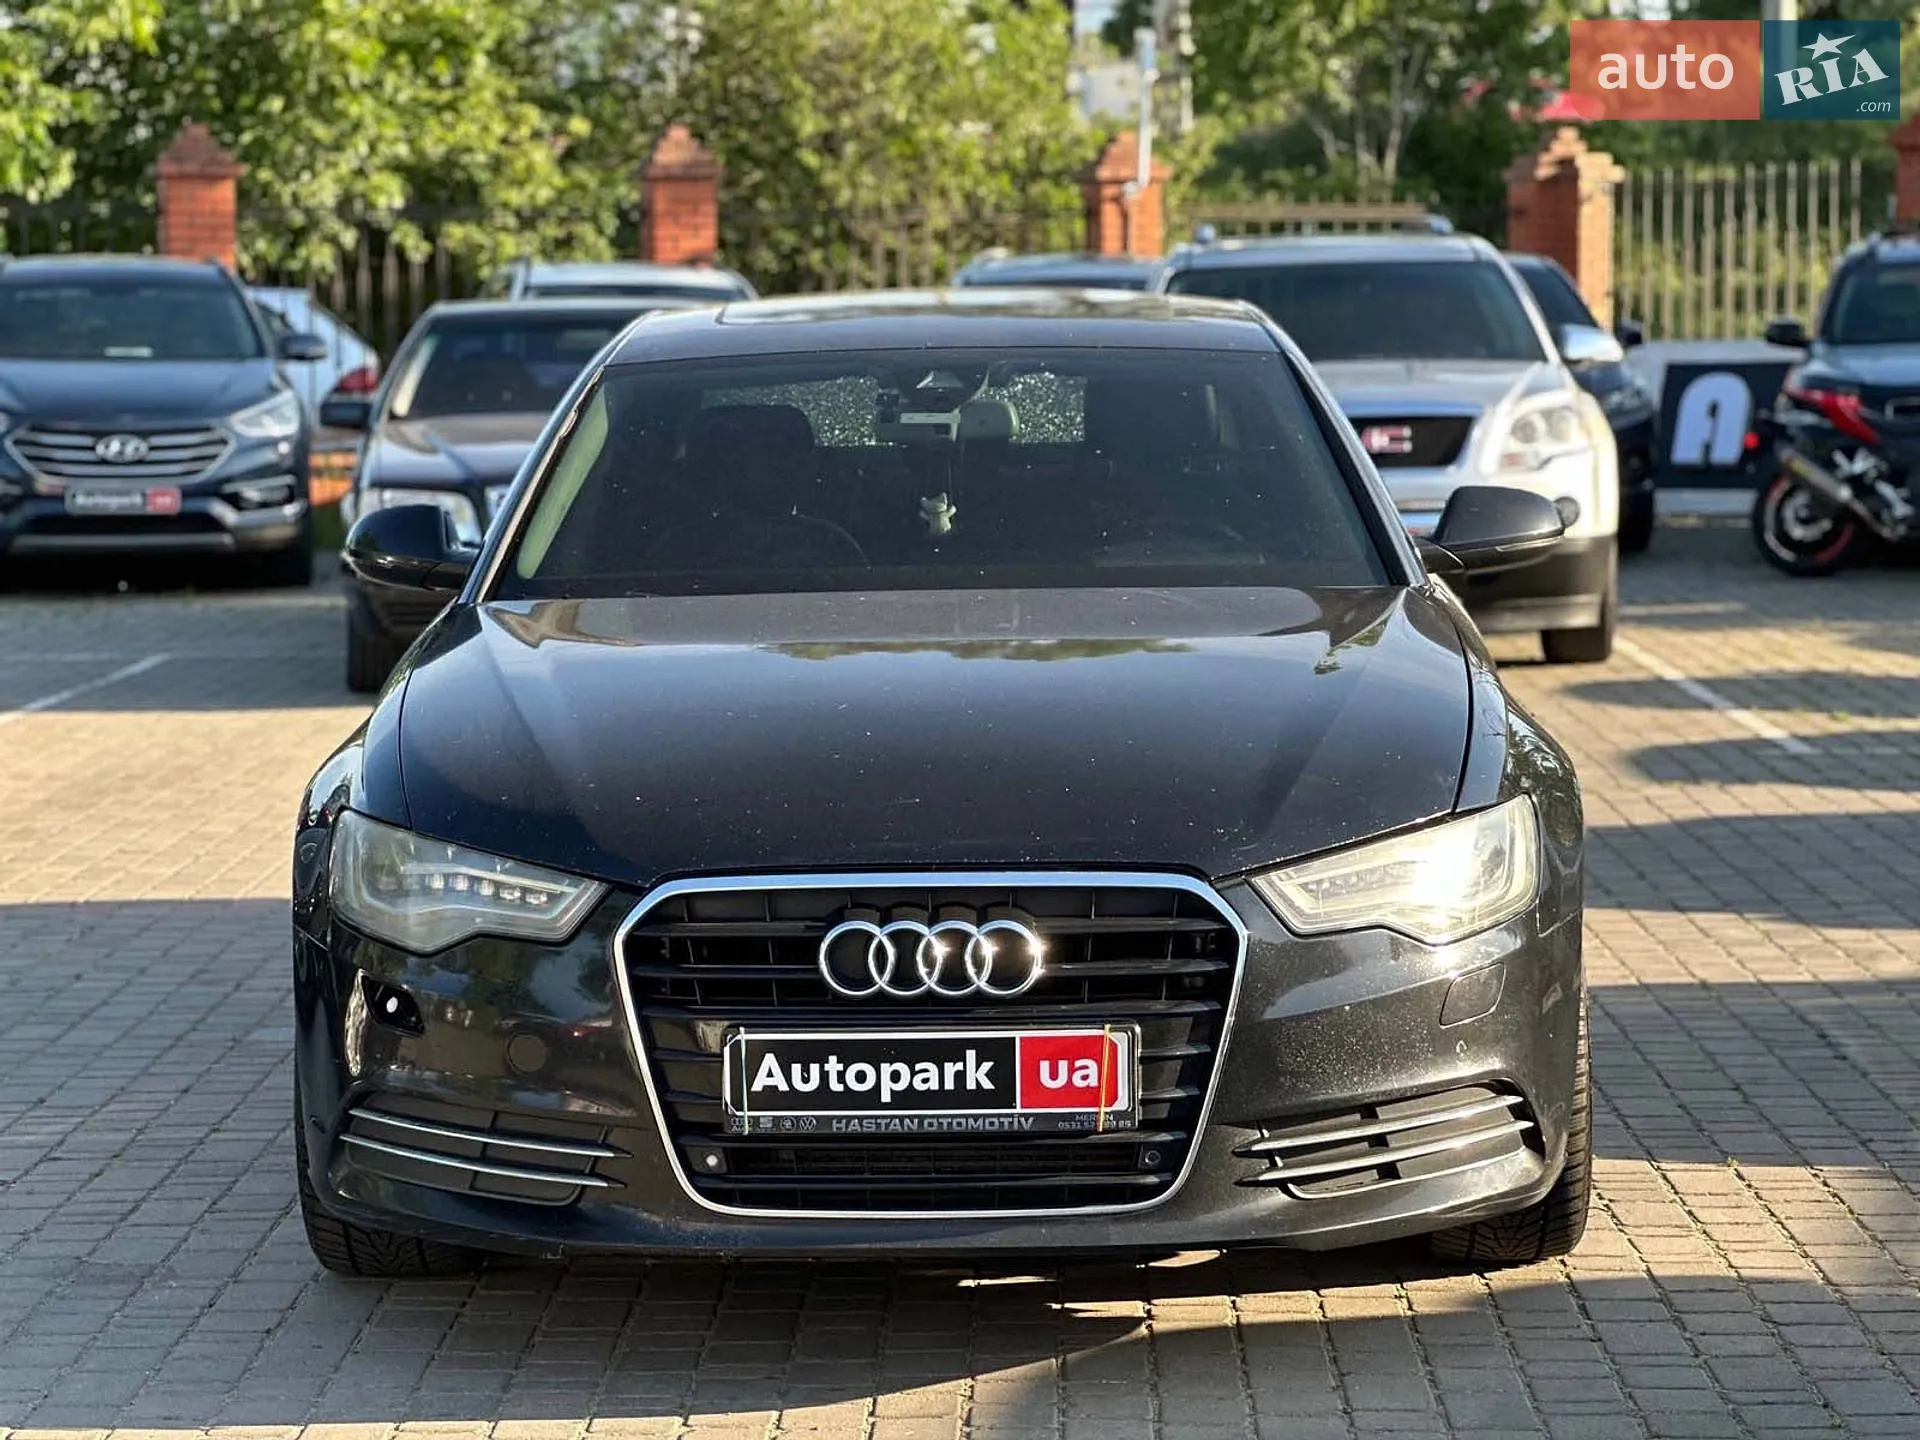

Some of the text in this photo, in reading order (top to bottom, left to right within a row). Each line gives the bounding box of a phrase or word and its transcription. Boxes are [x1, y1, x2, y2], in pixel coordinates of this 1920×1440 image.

[750, 1050, 1100, 1103] Autopark ua
[832, 1114, 1035, 1132] HASTAN OTOMOTİV
[1075, 1113, 1114, 1121] MERN
